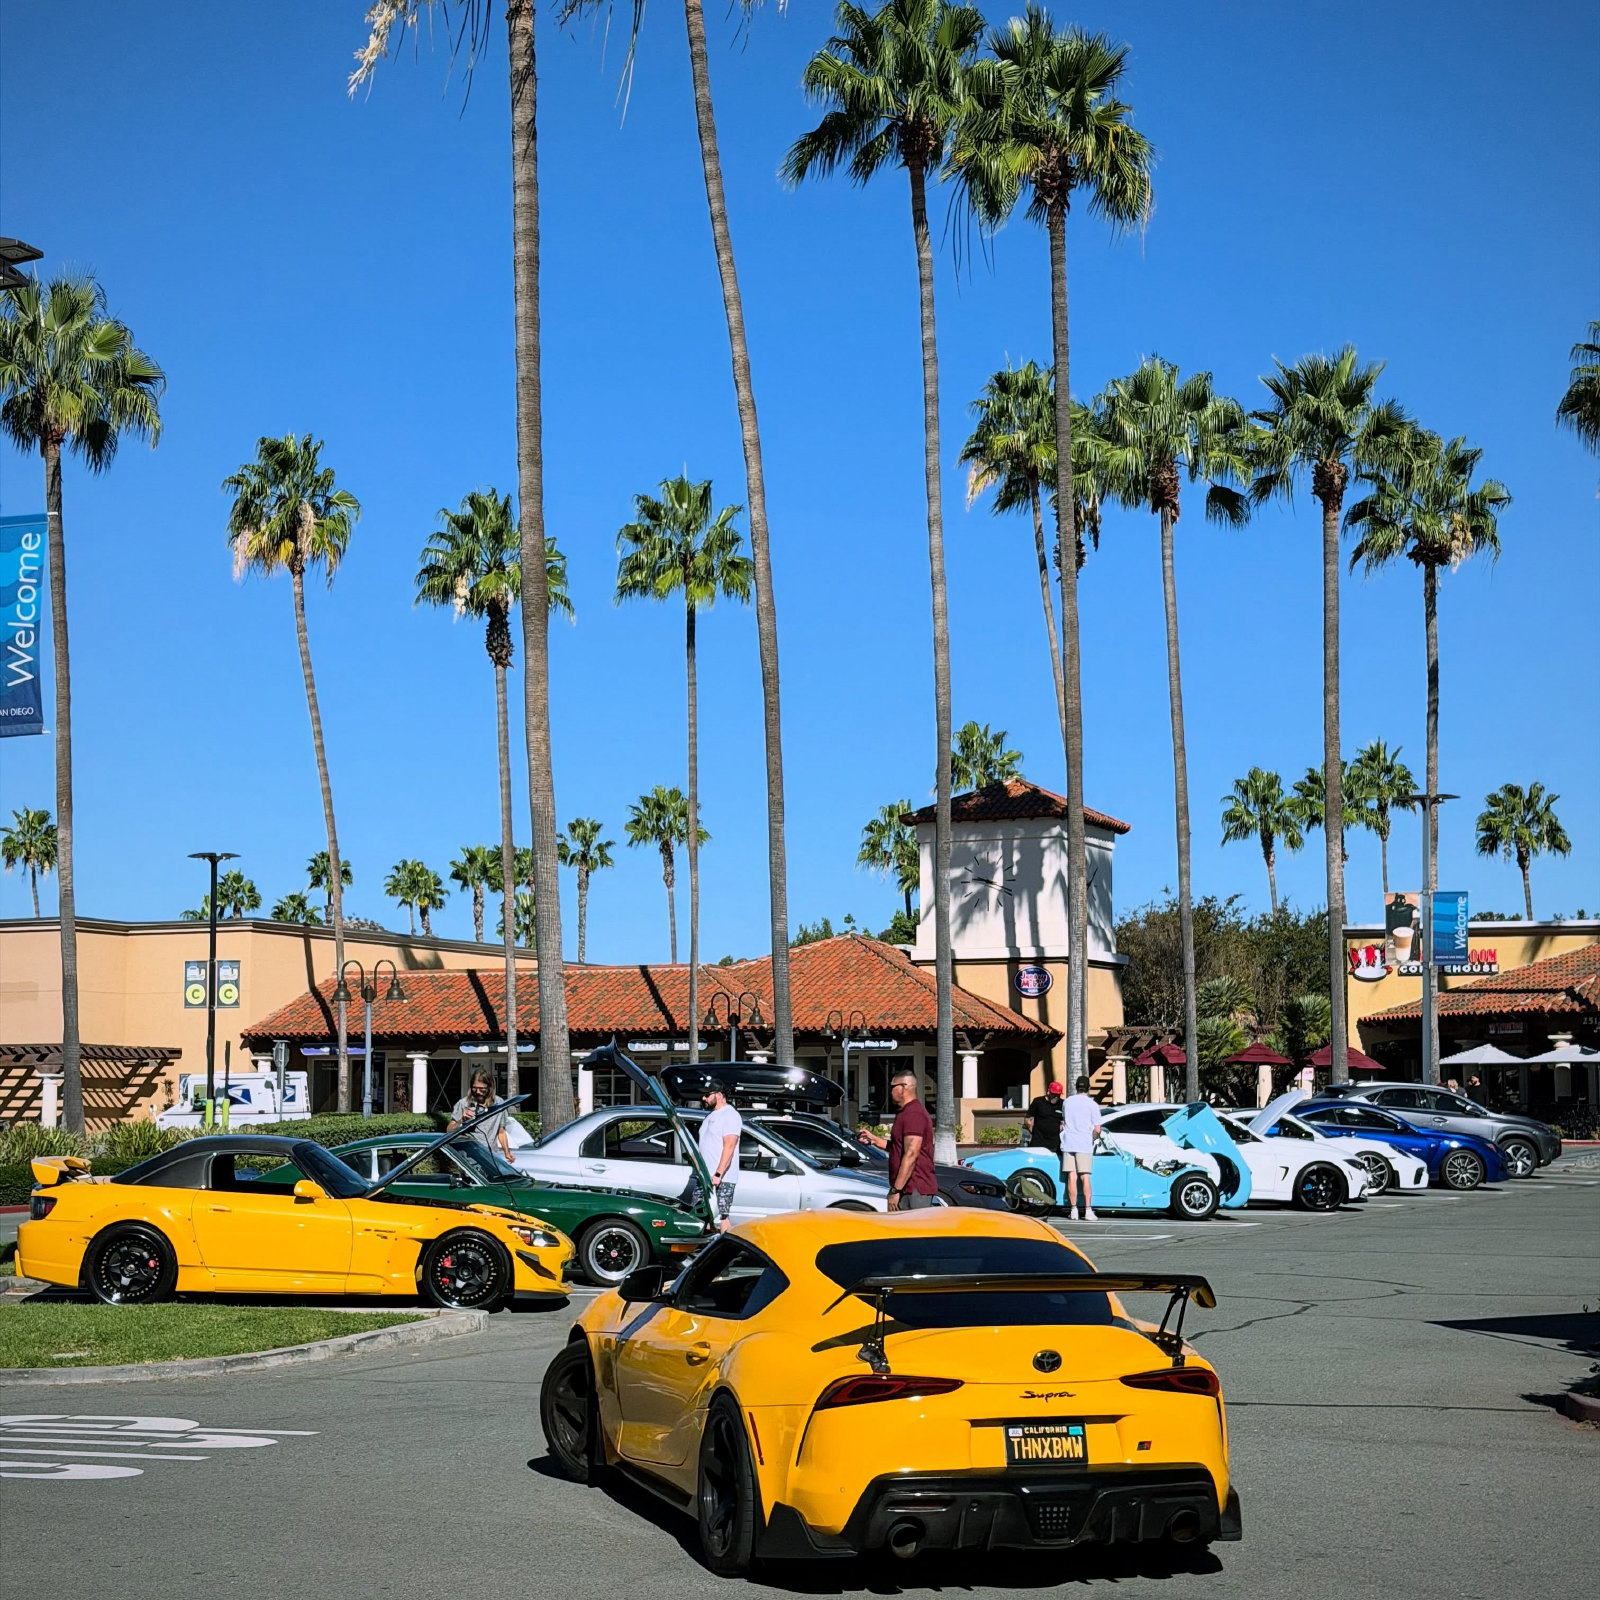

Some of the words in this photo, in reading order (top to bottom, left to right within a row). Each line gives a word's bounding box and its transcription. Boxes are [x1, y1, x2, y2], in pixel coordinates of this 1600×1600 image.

[7, 532, 41, 687] Welcome
[10, 707, 34, 717] DIEGO
[1454, 896, 1467, 950] Welcome
[1468, 949, 1498, 964] OOM
[1399, 964, 1499, 973] COFEHOUSE
[191, 988, 200, 999] C
[224, 988, 233, 999] C
[1582, 1016, 1600, 1025] 251
[1019, 1390, 1076, 1403] Supra
[1024, 1426, 1068, 1435] CALIFORNIA
[1010, 1436, 1084, 1459] THNXBMW
